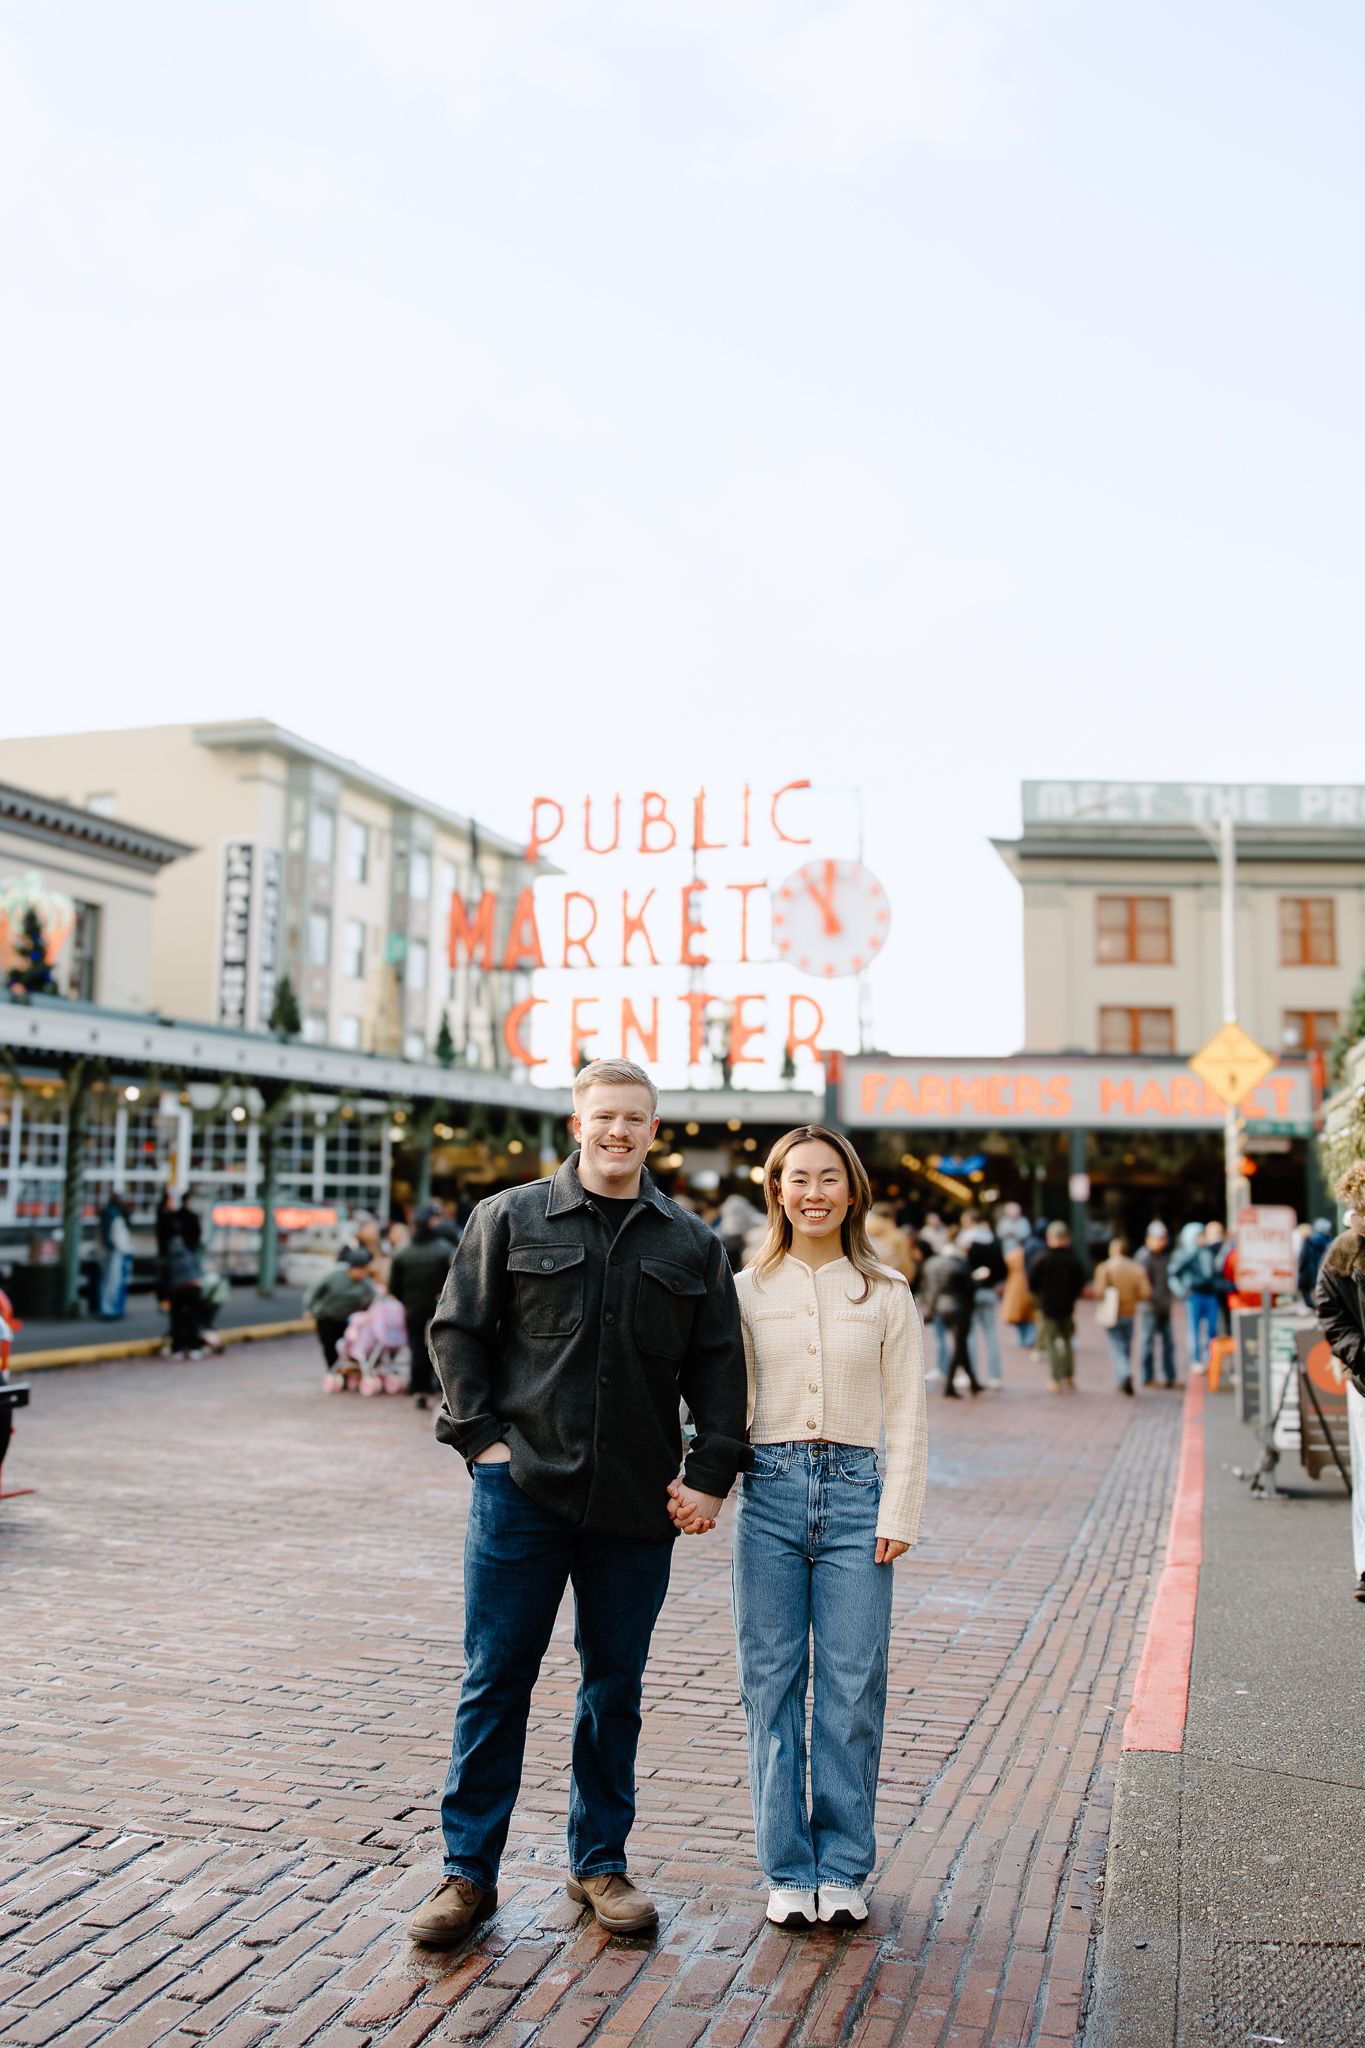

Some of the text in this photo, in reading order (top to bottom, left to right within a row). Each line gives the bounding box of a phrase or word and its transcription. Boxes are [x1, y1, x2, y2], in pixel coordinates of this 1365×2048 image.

[526, 780, 811, 862] PUBLIC
[1300, 787, 1365, 823] PR
[448, 880, 768, 970] MARKET
[504, 992, 823, 1067] CENTER
[861, 1073, 1073, 1117] FARMERS
